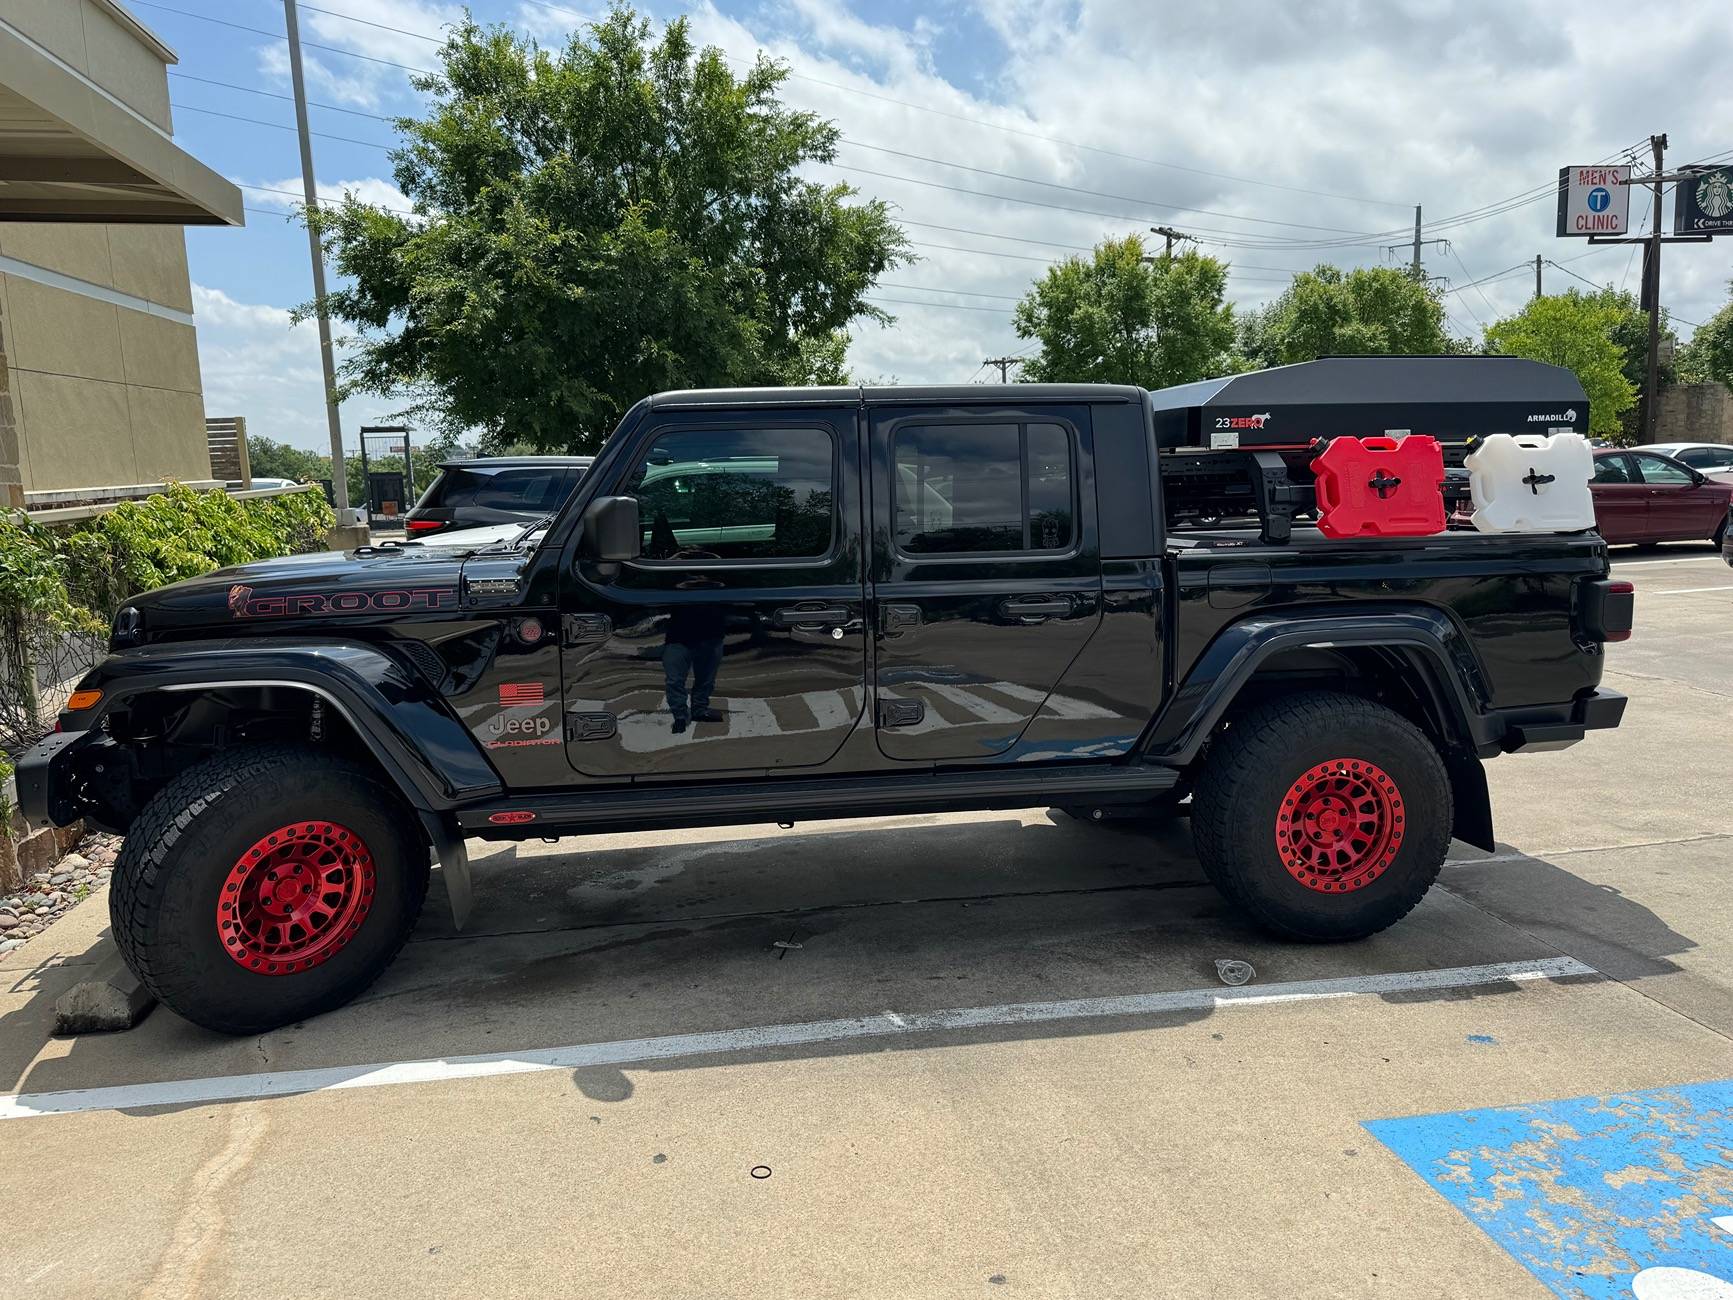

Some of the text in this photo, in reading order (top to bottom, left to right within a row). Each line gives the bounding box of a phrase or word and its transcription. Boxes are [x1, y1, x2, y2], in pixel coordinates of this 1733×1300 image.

[1579, 170, 1619, 185] MEN'S
[1592, 192, 1606, 210] T
[1576, 215, 1618, 230] CLINIC
[244, 588, 454, 617] GROOT
[488, 714, 550, 736] Jeep
